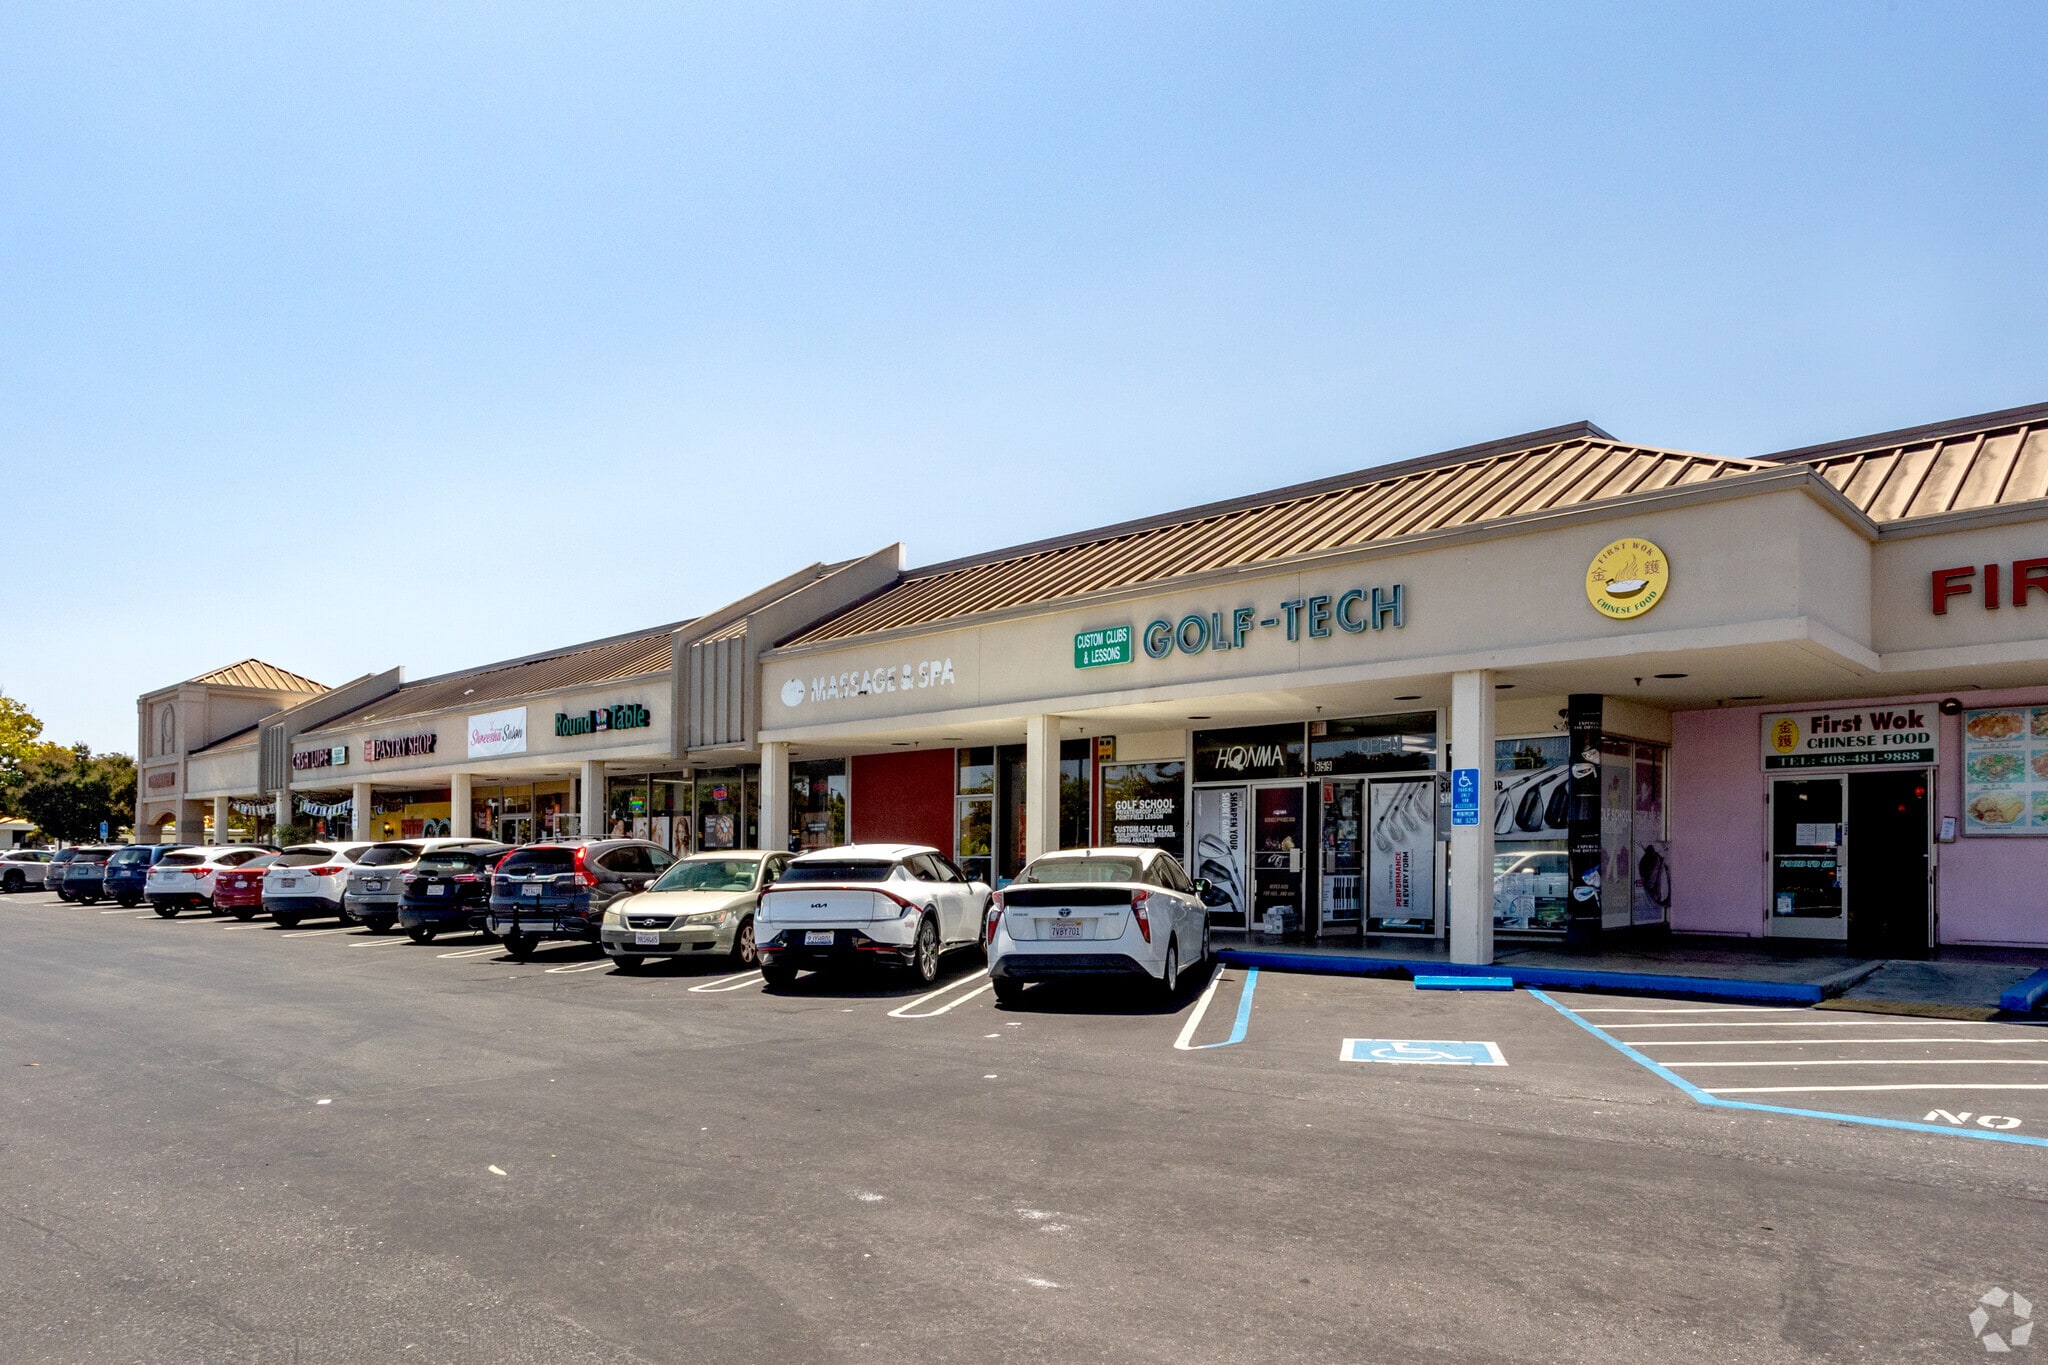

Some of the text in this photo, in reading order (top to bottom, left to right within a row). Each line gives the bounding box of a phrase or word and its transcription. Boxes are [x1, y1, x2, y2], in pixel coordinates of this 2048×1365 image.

[1598, 542, 1654, 564] FIRST WOK
[1591, 567, 1607, 583] 金
[1597, 591, 1657, 614] CHINESE FOOD
[1143, 583, 1404, 660] GOLF-TECH
[1077, 628, 1127, 648] CUSTOM CLUBS
[1083, 646, 1120, 664] & LESSONS
[810, 658, 955, 702] MASSAGE & SPA
[555, 711, 592, 736] Round
[609, 704, 646, 730] Table
[1811, 709, 1925, 734] First Wok
[375, 736, 406, 760] PASTRY
[408, 734, 433, 755] SHOP
[1807, 732, 1930, 749] CHINESE FOOD
[292, 752, 309, 770] CASA
[311, 750, 329, 767] LUPE
[1215, 745, 1284, 771] HONMA
[1314, 761, 1333, 772] 659
[1779, 751, 1920, 766] TEL: 408-481-9888
[1115, 799, 1175, 809] GOLF SCHOOL
[1221, 792, 1229, 817] SHORT
[1230, 792, 1238, 850] SHARPEN YOUR
[1780, 860, 1806, 868] FOOD
[1807, 860, 1820, 868] TO
[1402, 898, 1409, 907] IN
[1051, 927, 1080, 936] 7VBY701
[1923, 1108, 2022, 1129] NO
